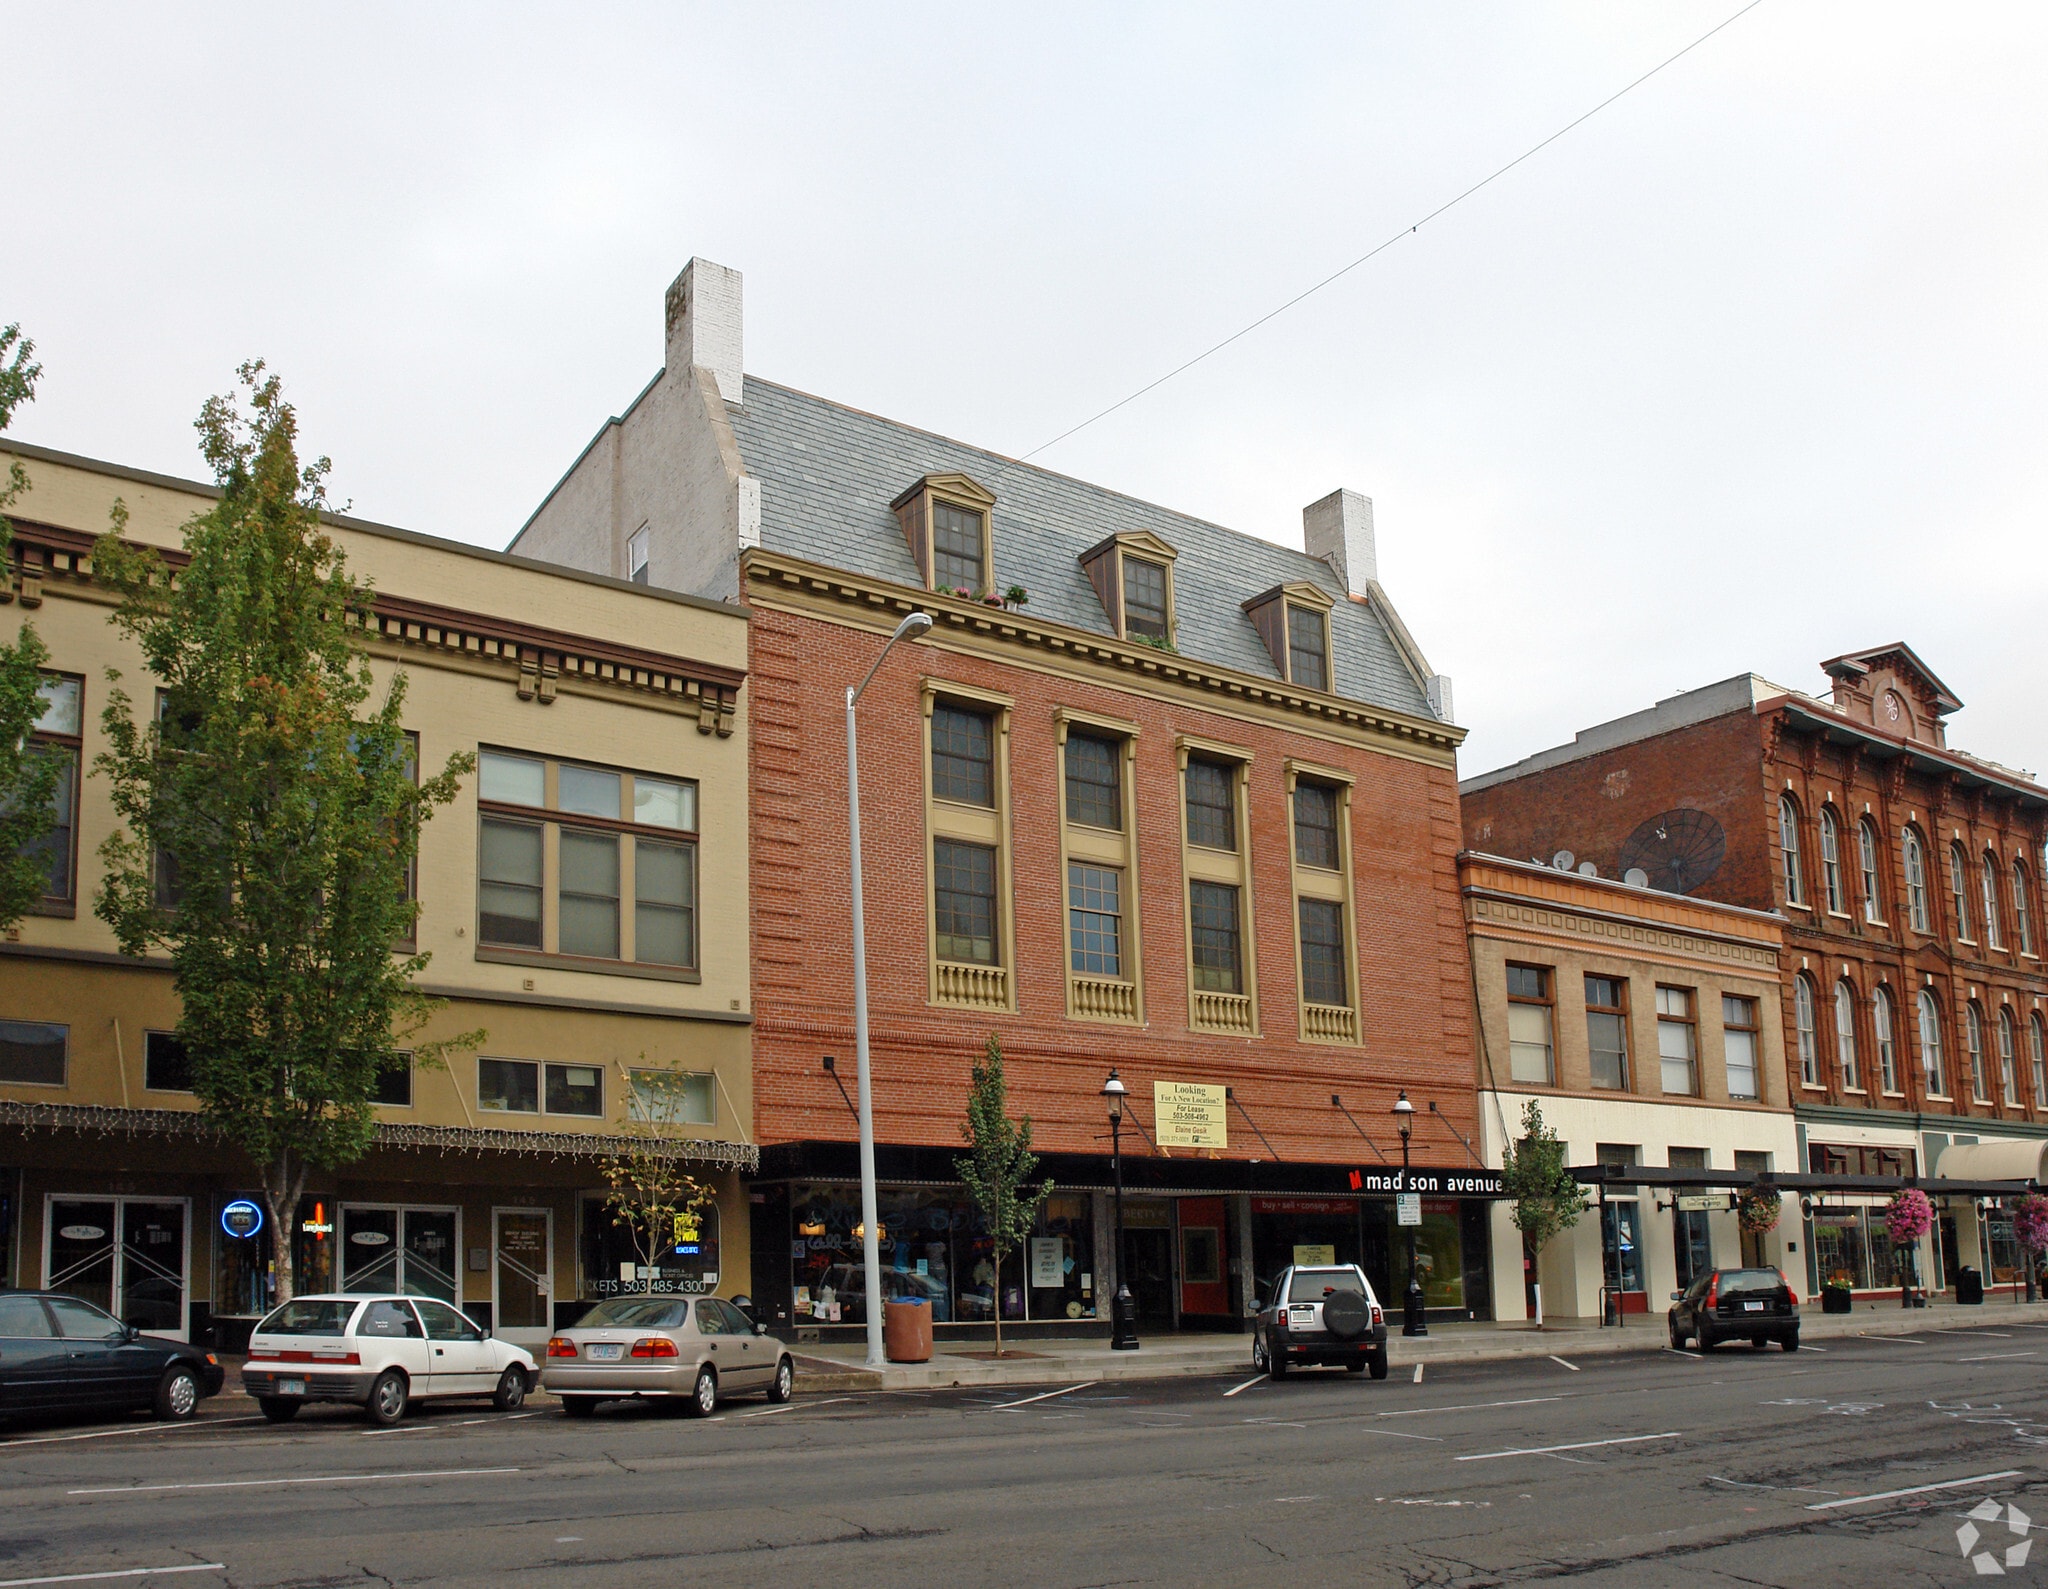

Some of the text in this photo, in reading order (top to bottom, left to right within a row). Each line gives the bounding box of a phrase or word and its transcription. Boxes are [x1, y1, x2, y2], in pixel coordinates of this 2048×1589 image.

[1174, 1084, 1206, 1097] Looking
[1161, 1094, 1171, 1102] For
[1188, 1105, 1205, 1113] Lease
[1367, 1171, 1438, 1191] madson
[1447, 1177, 1503, 1192] avenue
[1262, 1201, 1276, 1211] buy
[1282, 1201, 1295, 1209] sell
[1301, 1202, 1330, 1212] consign
